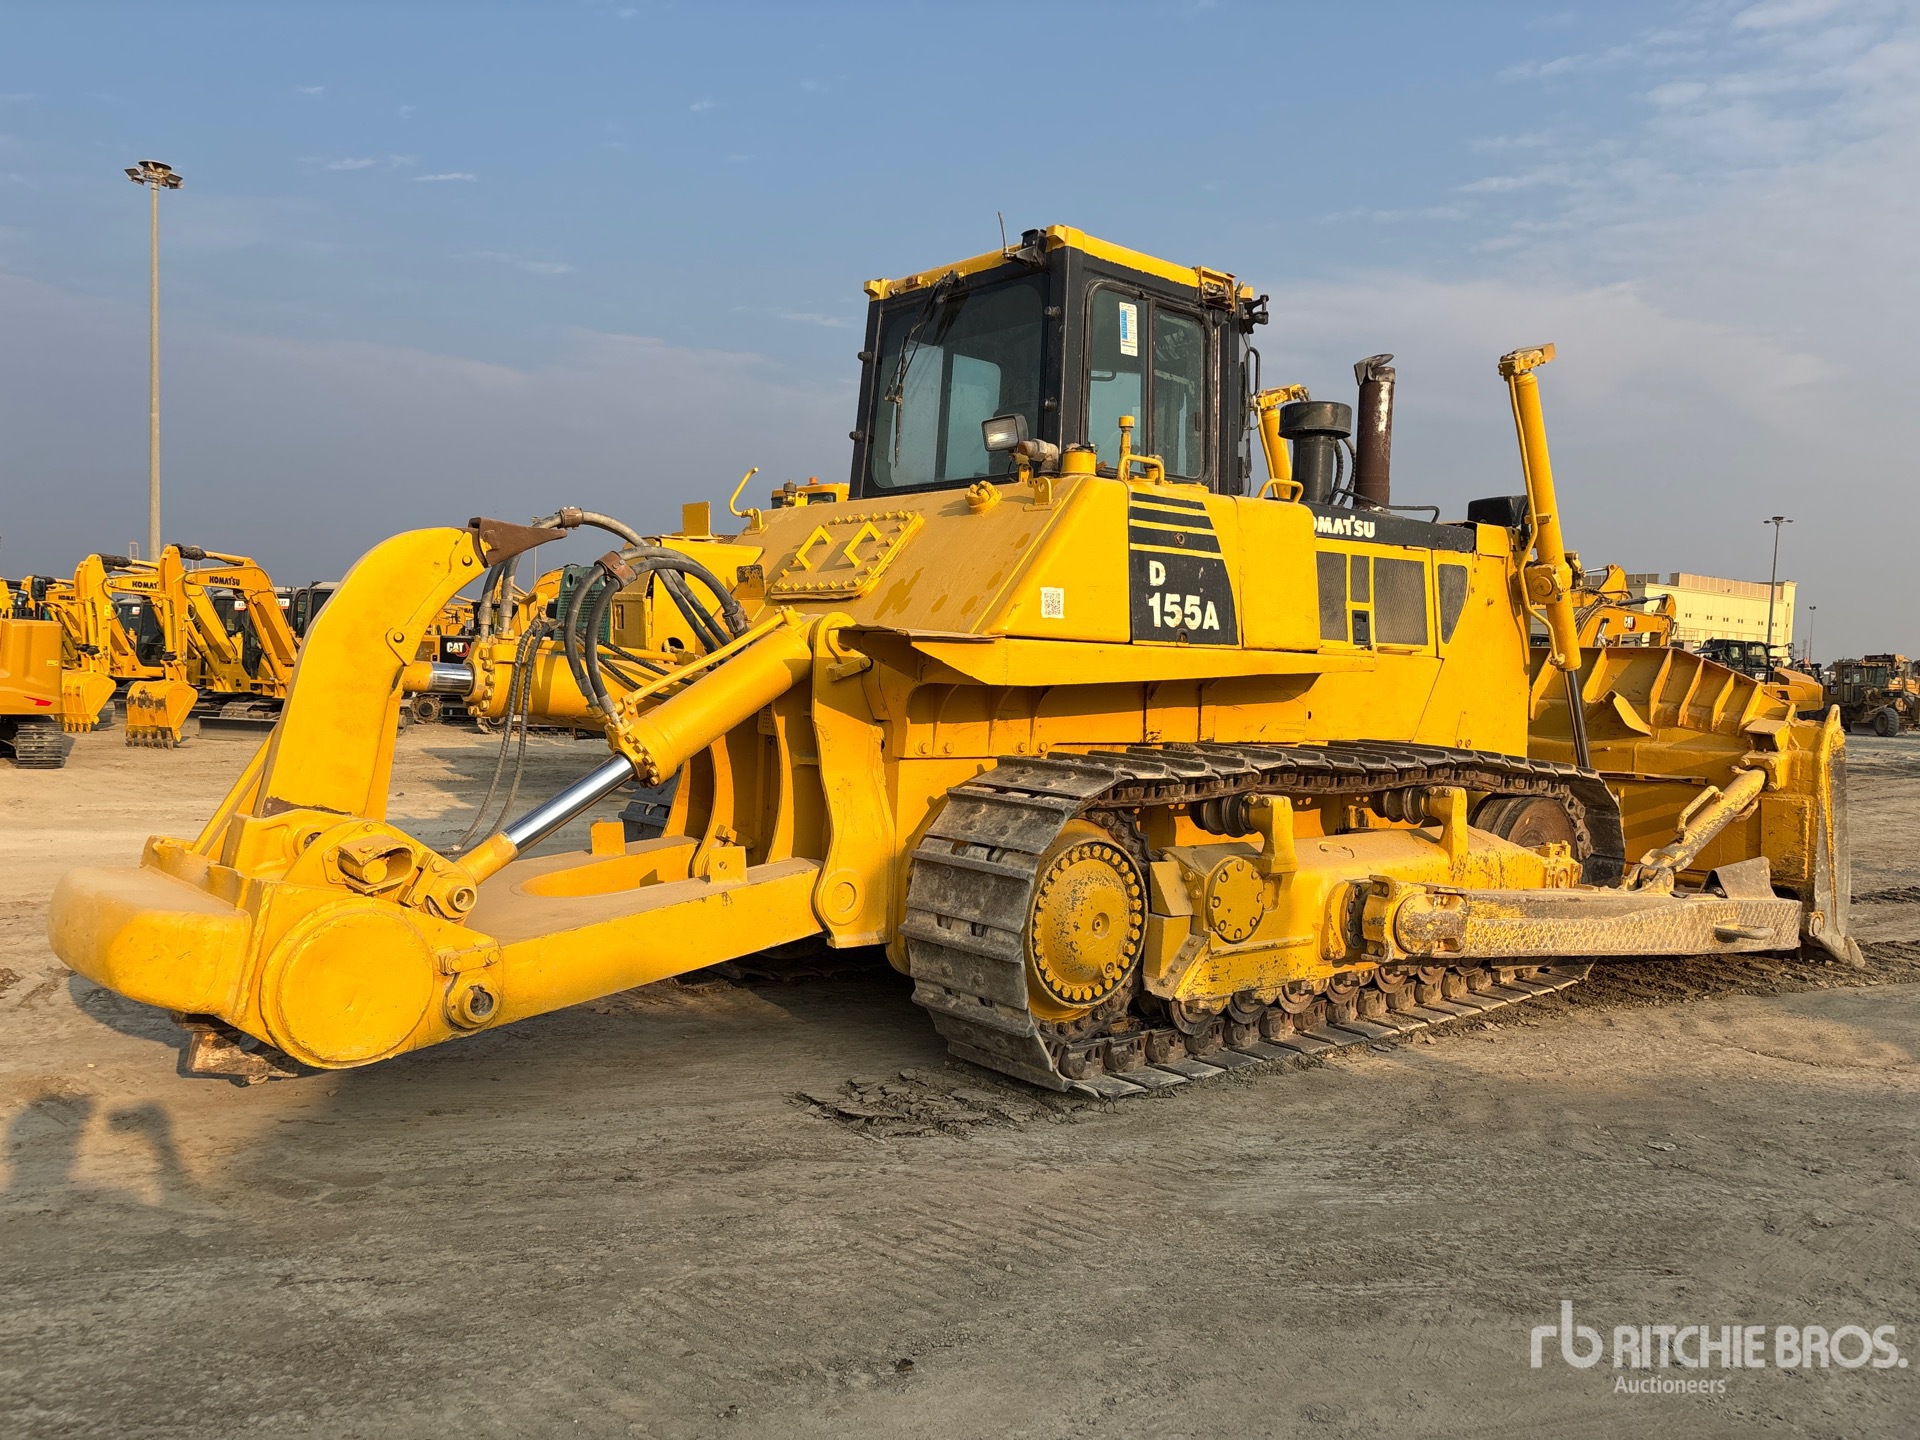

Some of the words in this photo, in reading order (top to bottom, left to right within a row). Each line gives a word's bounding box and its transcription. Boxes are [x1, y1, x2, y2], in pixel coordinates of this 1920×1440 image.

[209, 575, 241, 586] KOMATSU
[1149, 560, 1166, 587] D
[1148, 592, 1220, 631] 155A
[446, 642, 464, 653] CAT
